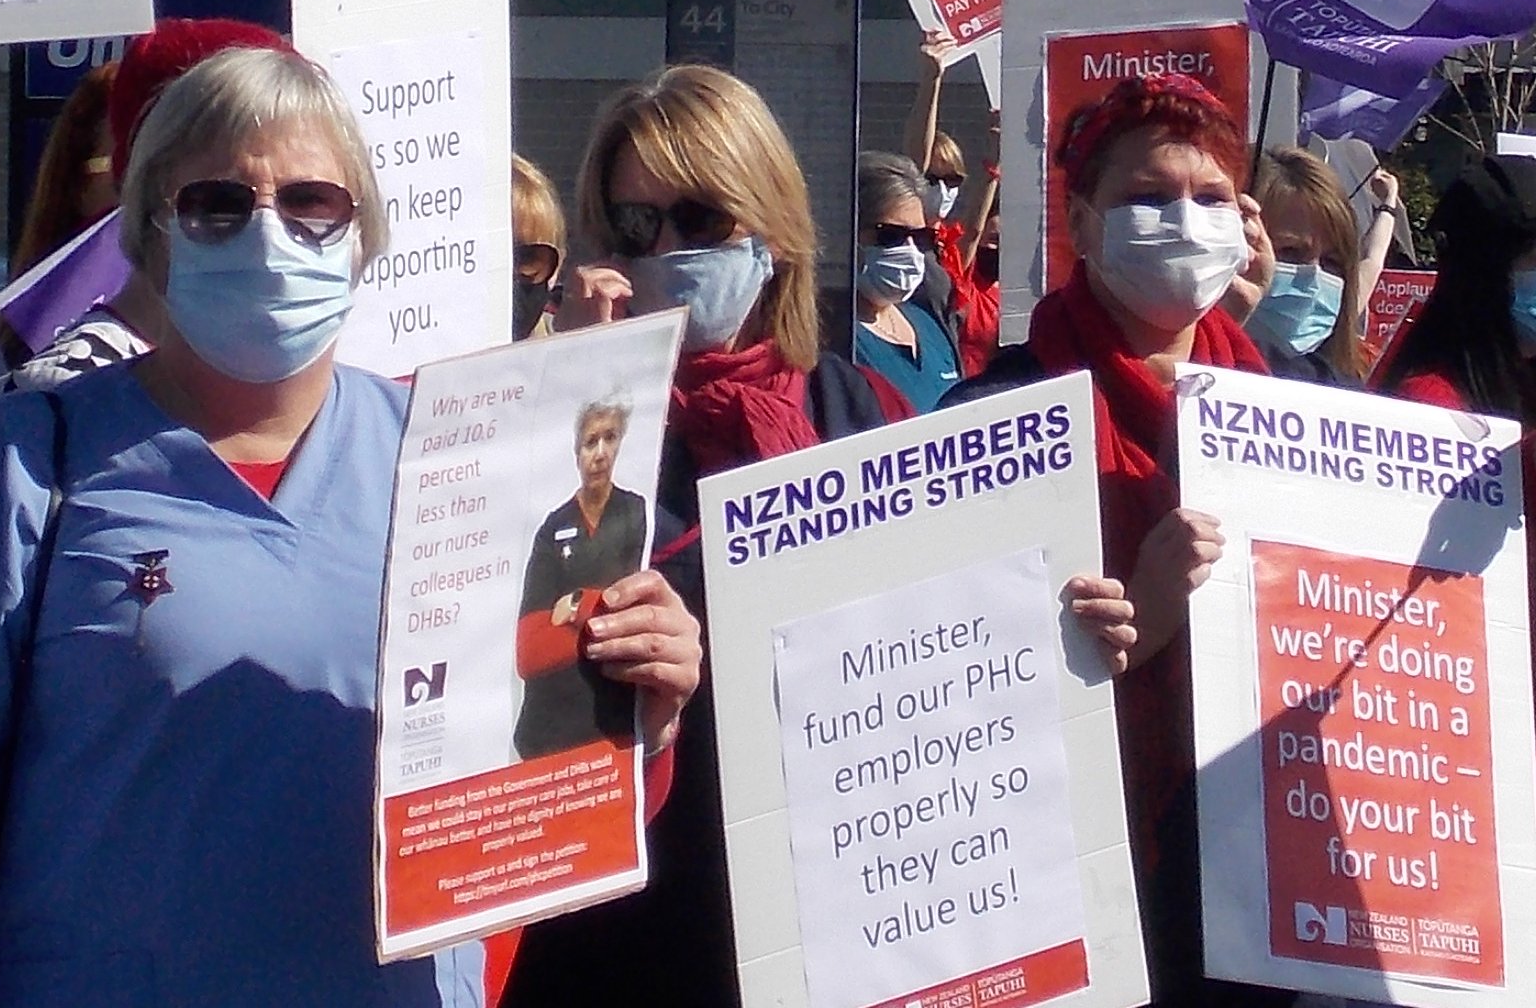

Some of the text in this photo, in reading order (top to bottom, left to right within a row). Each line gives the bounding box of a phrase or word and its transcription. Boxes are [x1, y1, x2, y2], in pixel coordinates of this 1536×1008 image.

[680, 4, 727, 34] 44
[764, 0, 796, 19] City
[1083, 49, 1214, 81] Minister,
[362, 71, 455, 118] Support
[394, 131, 460, 166] so we
[409, 184, 462, 221] keep
[389, 304, 438, 344] you.
[432, 385, 525, 419] Why are we
[421, 419, 497, 456] paid 10.6
[1199, 397, 1503, 477] NZNO MEMBERS
[419, 459, 481, 493] percent
[724, 404, 1070, 533] NZNO MEMBERS
[1200, 433, 1504, 507] STANDING STRONG
[416, 495, 486, 524] less than
[727, 442, 1072, 566] STANDING STRONG
[413, 529, 489, 561] our nurse
[411, 557, 511, 598] colleagues in
[407, 602, 461, 634] DHBs?
[1298, 569, 1446, 637] Minister,
[841, 614, 990, 684] Minister,
[1378, 635, 1475, 694] doing
[803, 648, 1036, 749] fund our PHC
[1281, 679, 1469, 736] our bit in a
[835, 714, 1015, 793] employers
[1278, 731, 1448, 784] pandemic
[832, 767, 1028, 858] properly so
[1286, 779, 1477, 843] do your bit
[861, 826, 1010, 894] they can
[1326, 837, 1439, 890] for us!
[863, 867, 1019, 948] value us!
[1350, 921, 1410, 943] NURSES
[1419, 933, 1481, 954] TAPUHI
[977, 977, 1026, 1000] TAPUHI
